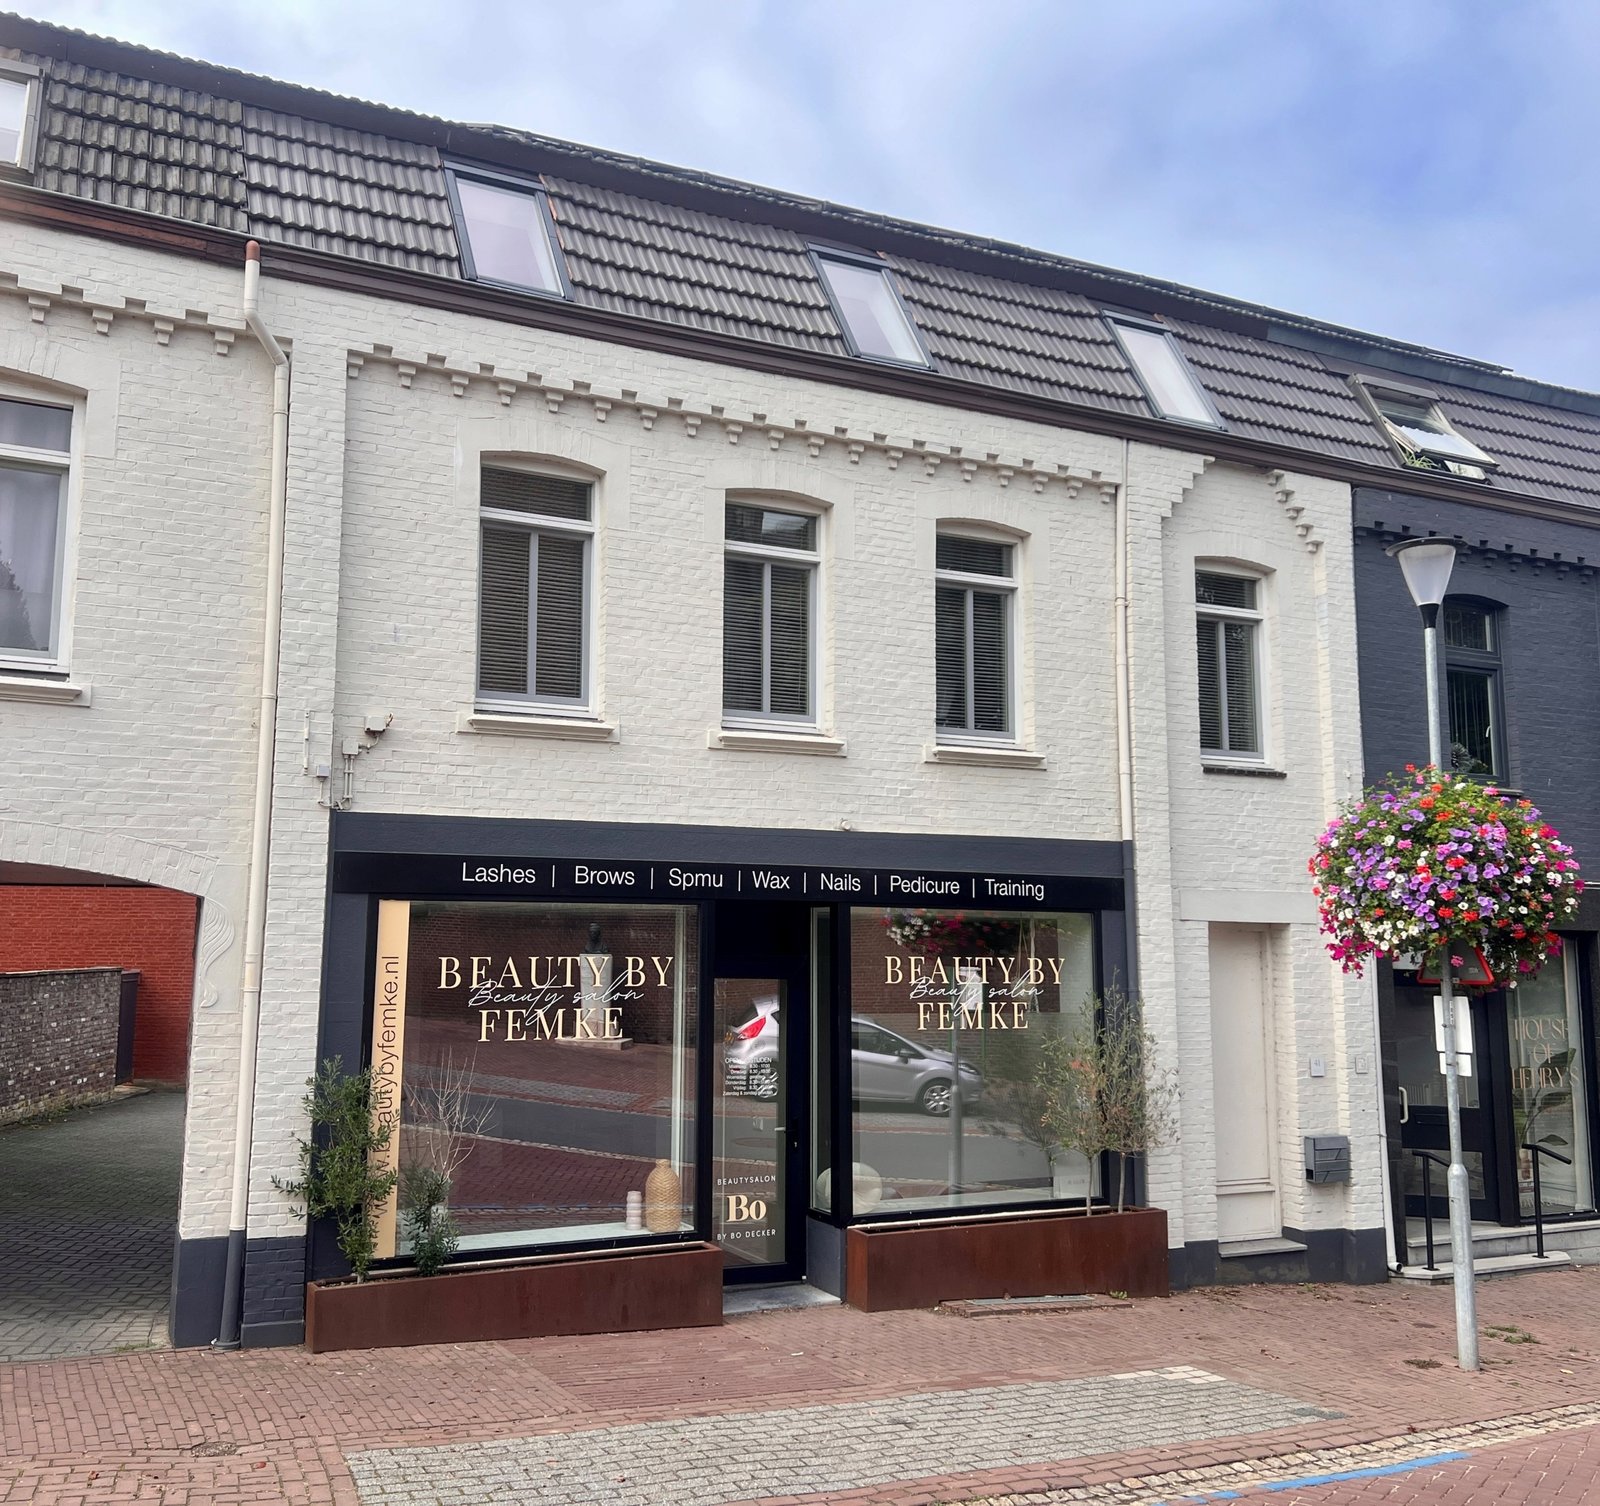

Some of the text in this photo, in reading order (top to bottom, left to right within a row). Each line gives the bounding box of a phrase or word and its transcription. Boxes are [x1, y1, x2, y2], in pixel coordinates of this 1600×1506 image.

[462, 862, 536, 884] Lashes
[575, 865, 635, 886] Brows
[668, 868, 723, 891] Spmu
[752, 870, 790, 889] Wax
[820, 873, 861, 892] Nails
[890, 875, 960, 895] Pedicure
[984, 878, 1045, 901] Training
[437, 955, 674, 990] BEAUTY BY
[884, 955, 1065, 985] BEAUTY BY
[467, 968, 645, 1027] Beauty salon
[909, 968, 1044, 1018] Beauty salon
[477, 1006, 624, 1043] FEMKE
[916, 1001, 1029, 1031] FEMKE
[717, 1175, 776, 1186] BEAUTYSALON
[726, 1193, 767, 1223] Bo
[717, 1228, 776, 1241] BY BO DECKER
